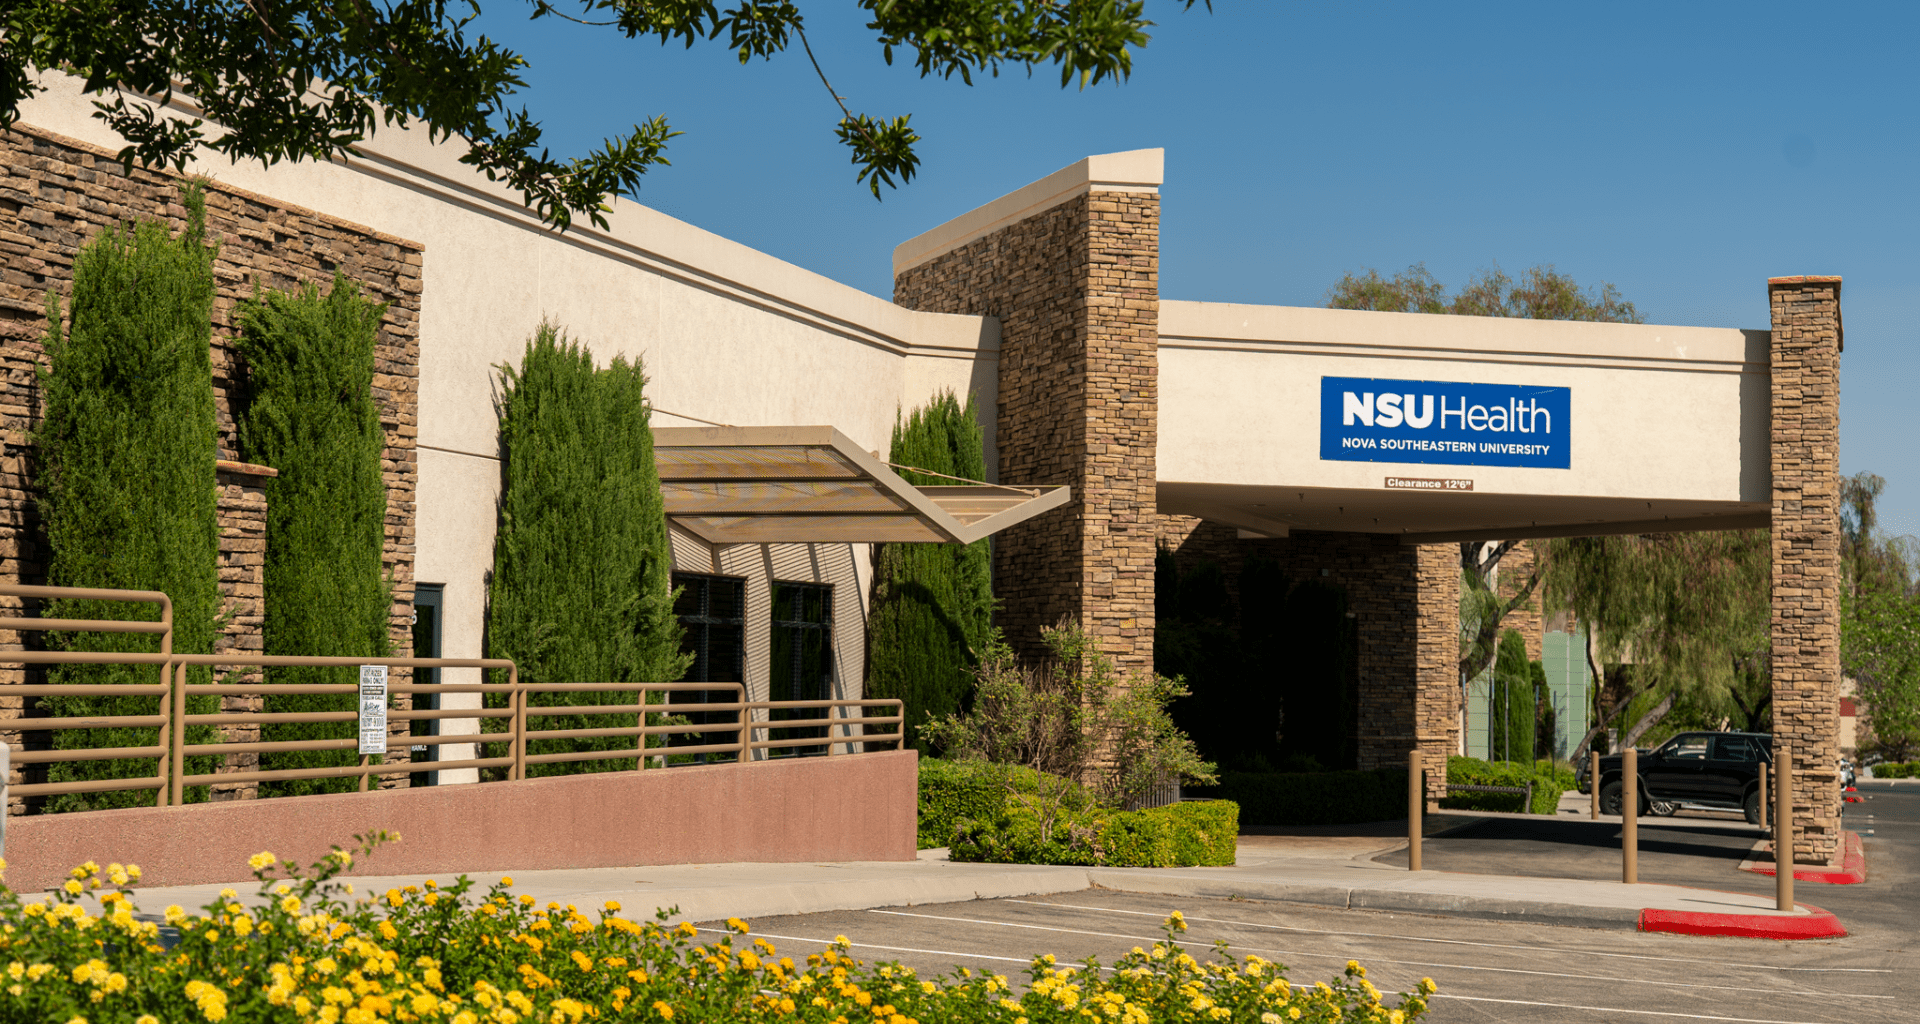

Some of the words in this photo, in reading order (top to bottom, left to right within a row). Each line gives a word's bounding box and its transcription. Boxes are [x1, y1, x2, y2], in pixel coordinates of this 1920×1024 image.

[1343, 391, 1434, 429] NSU
[1440, 395, 1551, 434] Health
[1342, 437, 1377, 449] NOVA
[1380, 438, 1476, 453] SOUTHEASTERN
[1479, 442, 1550, 456] UNIVERSITY
[1387, 478, 1442, 489] Clearance
